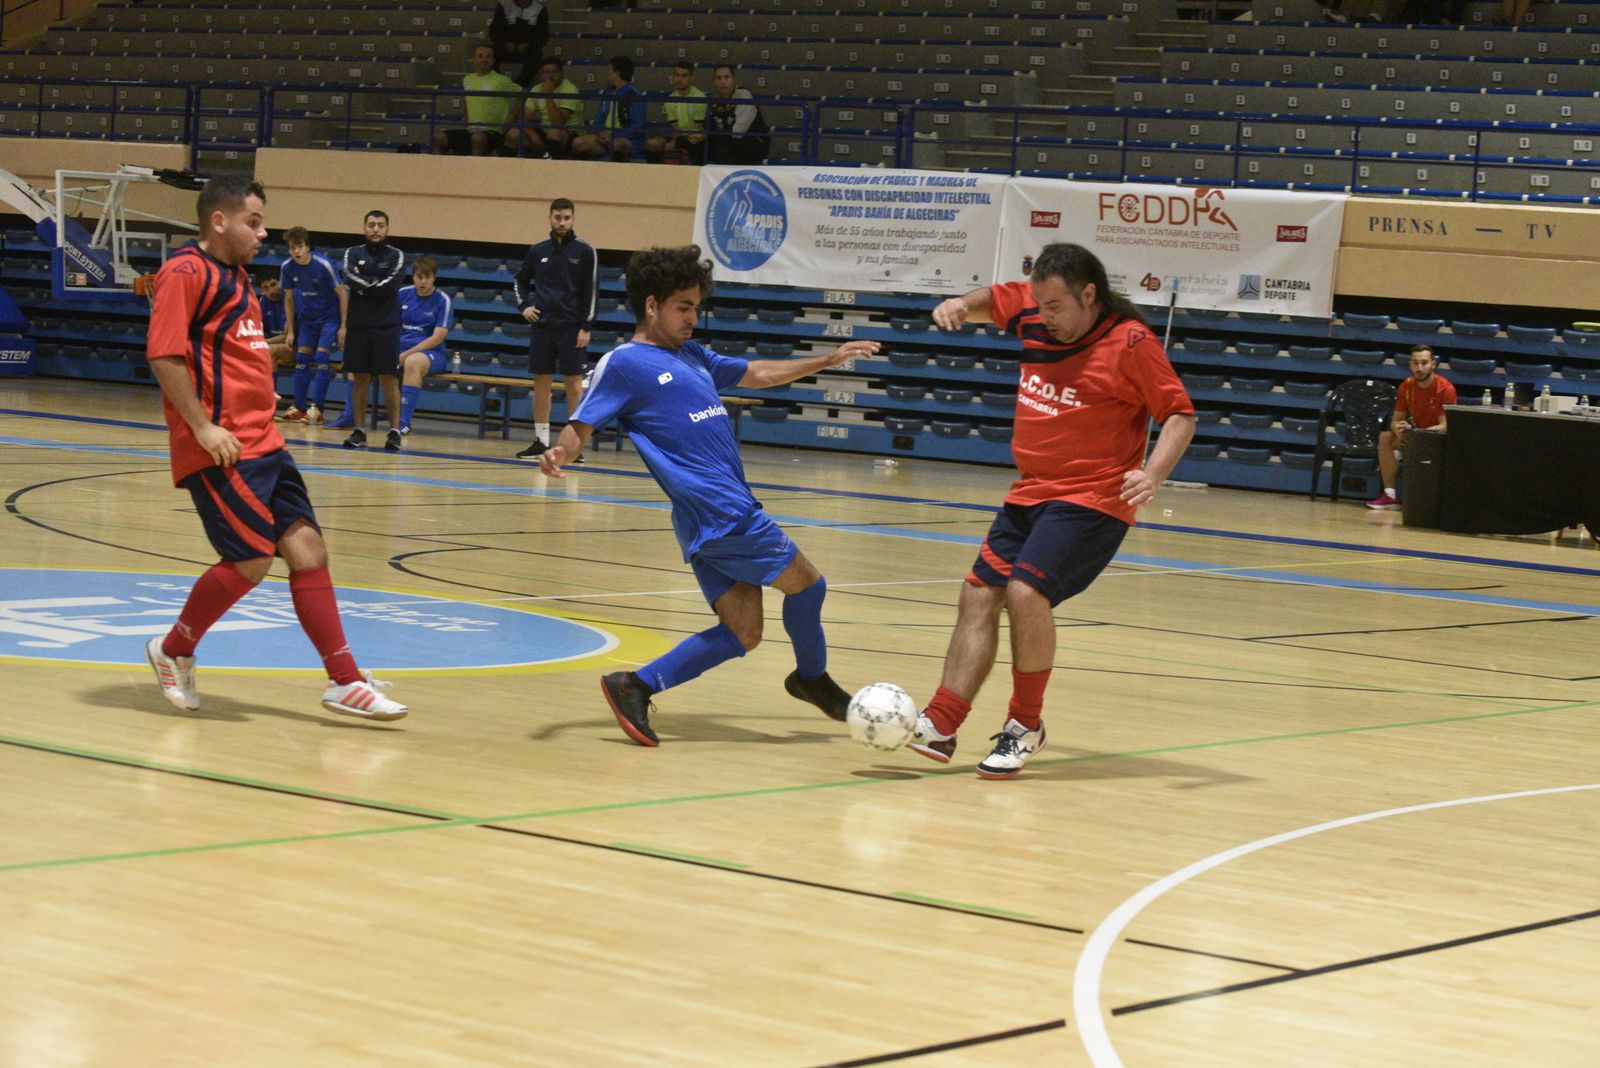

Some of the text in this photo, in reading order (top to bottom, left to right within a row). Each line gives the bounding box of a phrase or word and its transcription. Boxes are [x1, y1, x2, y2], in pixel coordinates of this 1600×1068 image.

[813, 173, 979, 187] ASOCIACIÓN DE PADRES Y MADRES DE
[798, 187, 991, 205] PERSONAS CON DISCAPACIDAD INTELECTUAL
[864, 205, 891, 219] BAHÍA
[893, 208, 905, 220] DE
[746, 214, 784, 229] APADIS
[1369, 216, 1448, 236] PRENSA
[1526, 223, 1557, 239] TV
[815, 224, 967, 241] Más de 55 años trabajando junto
[1097, 225, 1146, 234] FEDERACIÓN
[1190, 230, 1201, 239] DE
[1202, 231, 1240, 240] DEPORTE
[815, 238, 967, 254] a las personas con discapacidad
[1096, 235, 1240, 252] PARA DISCAPACITADOS INTELECTUALES
[880, 254, 919, 266] familias
[1265, 278, 1311, 291] CANTABRIA
[824, 292, 855, 304] FILA 5
[1264, 290, 1296, 301] DEPORTE
[844, 326, 852, 336] 4
[0, 350, 31, 361] STEM
[825, 392, 845, 402] FILA
[1018, 394, 1058, 416] CANTABRIA
[818, 426, 839, 436] FILA
